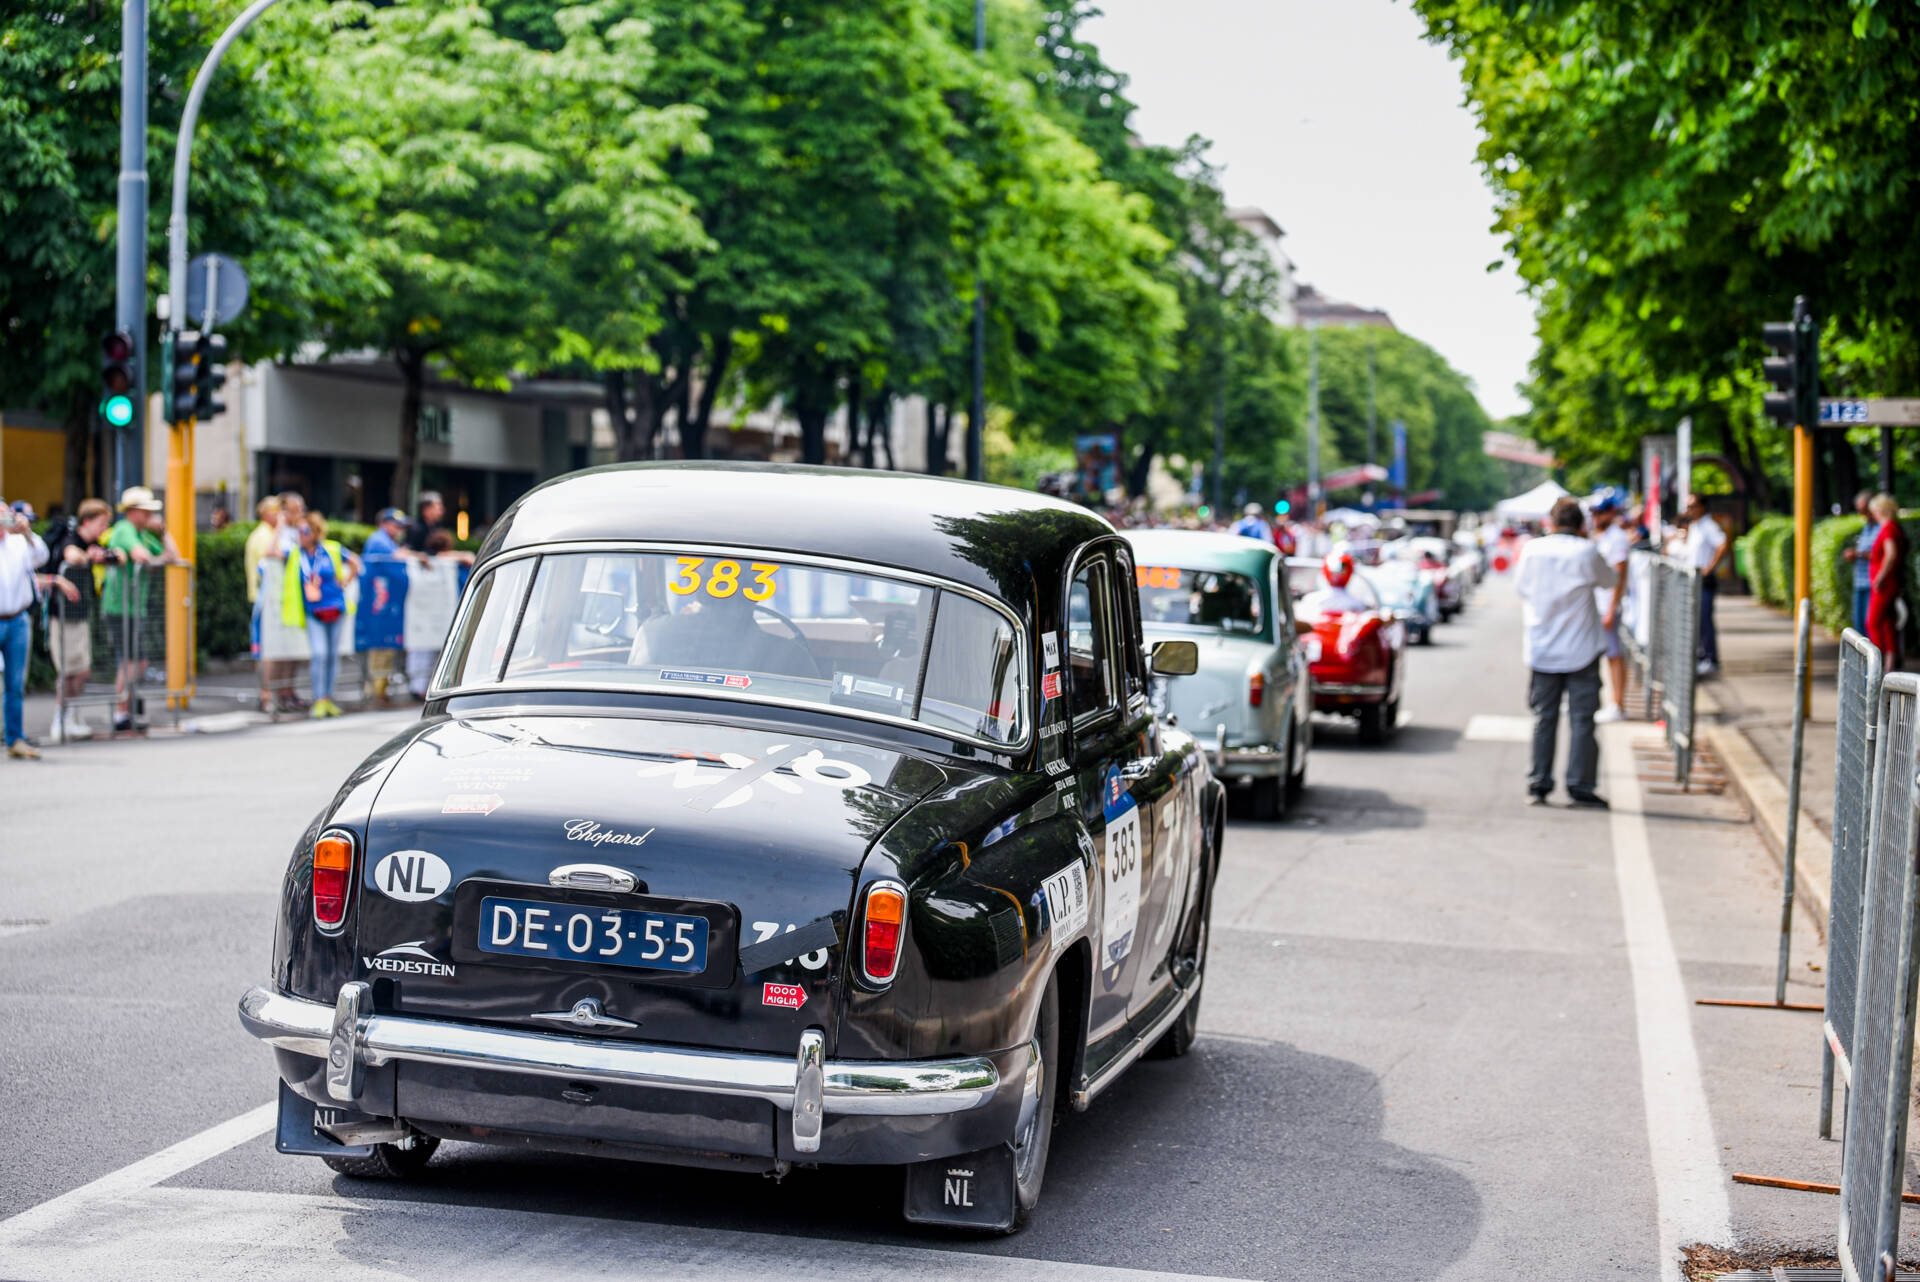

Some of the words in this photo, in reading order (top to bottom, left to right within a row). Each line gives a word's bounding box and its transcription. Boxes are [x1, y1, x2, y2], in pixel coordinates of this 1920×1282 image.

[668, 556, 780, 602] 383
[1045, 757, 1071, 776] OFFICIAL
[563, 819, 655, 847] Chopard
[1111, 820, 1135, 883] 383
[387, 855, 436, 894] NL
[362, 956, 455, 977] VREDESTEIN
[766, 995, 798, 1005] MIGLIA
[769, 986, 797, 995] 1000
[944, 1178, 973, 1206] NL
